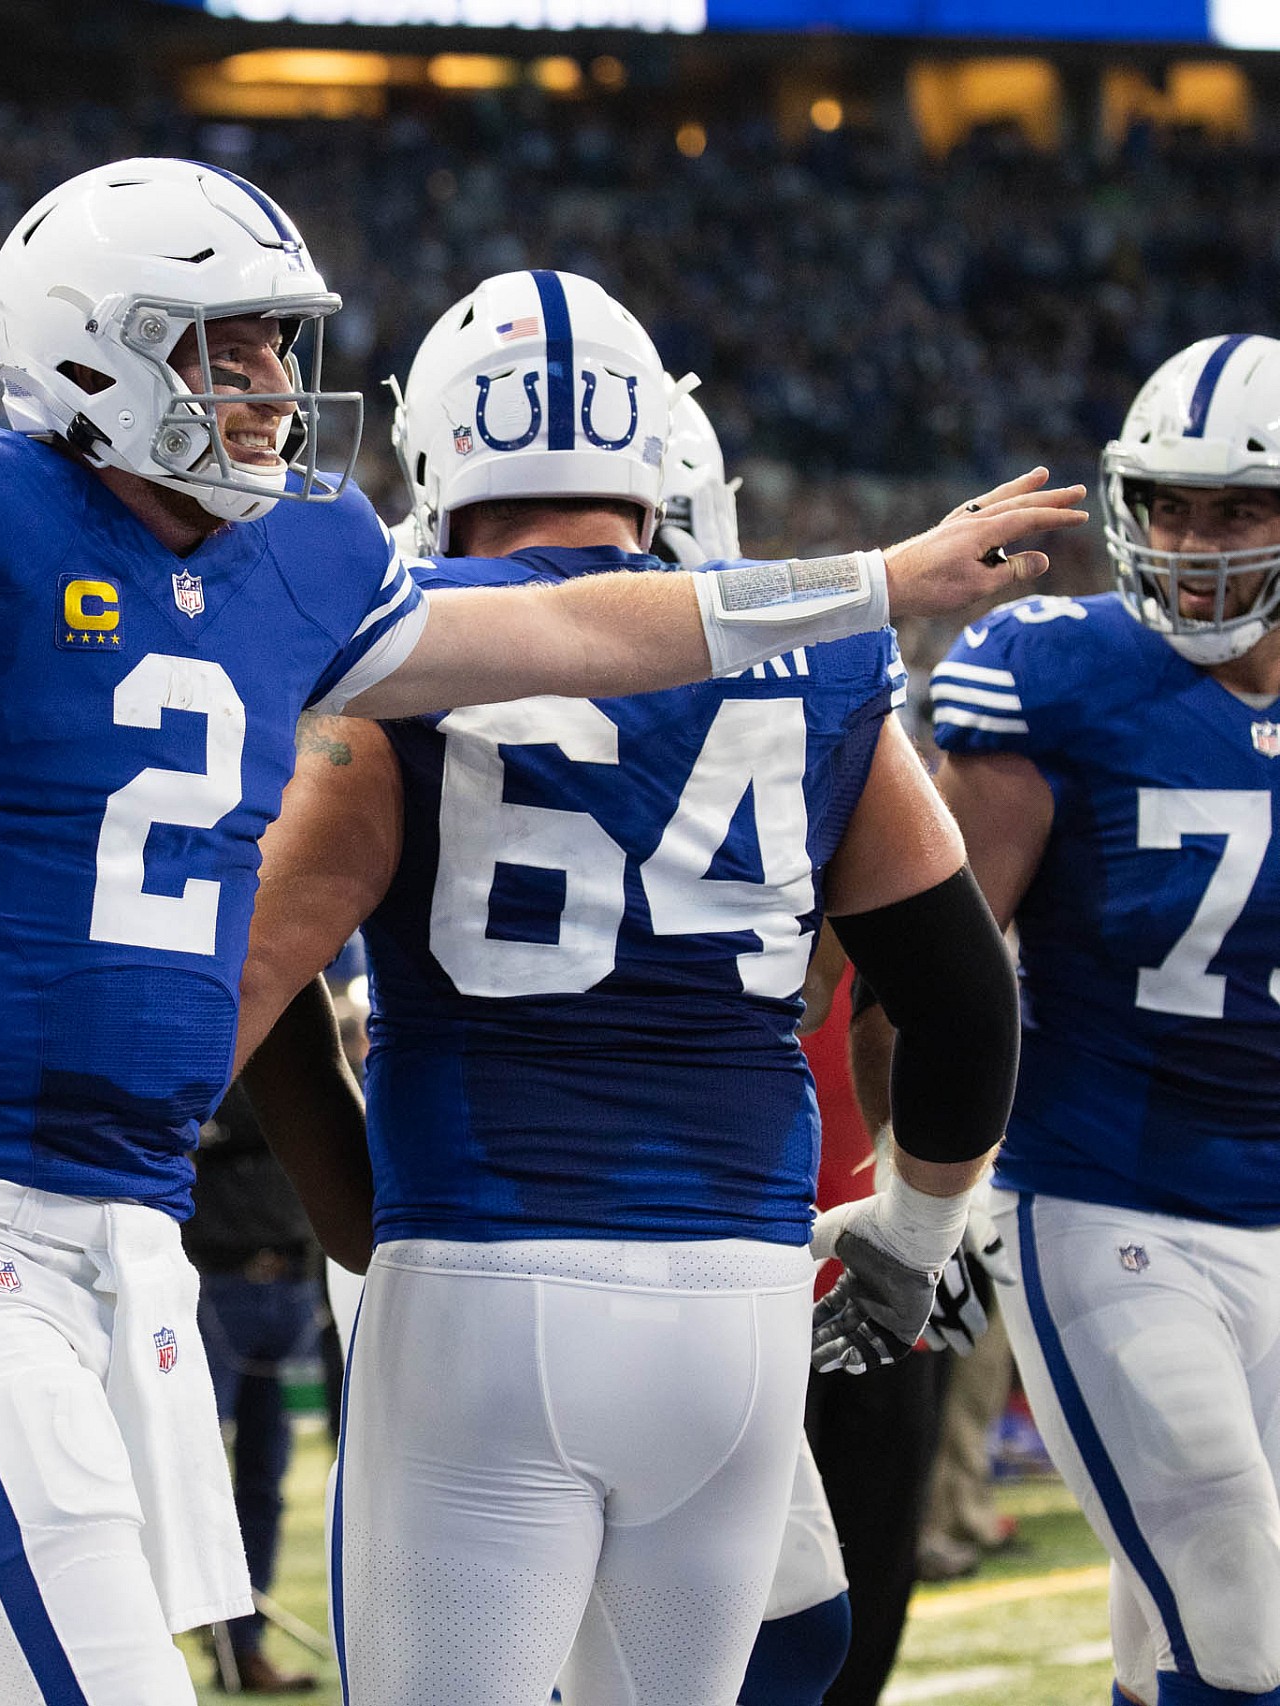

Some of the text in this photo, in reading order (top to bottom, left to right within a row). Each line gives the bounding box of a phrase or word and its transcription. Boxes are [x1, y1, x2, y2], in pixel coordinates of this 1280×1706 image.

[455, 438, 472, 451] NFL
[64, 580, 120, 630] C
[179, 590, 201, 608] NFL
[90, 653, 246, 955] 2
[429, 695, 816, 1000] 64
[1135, 787, 1280, 1019] 7
[159, 1346, 177, 1369] NFL
